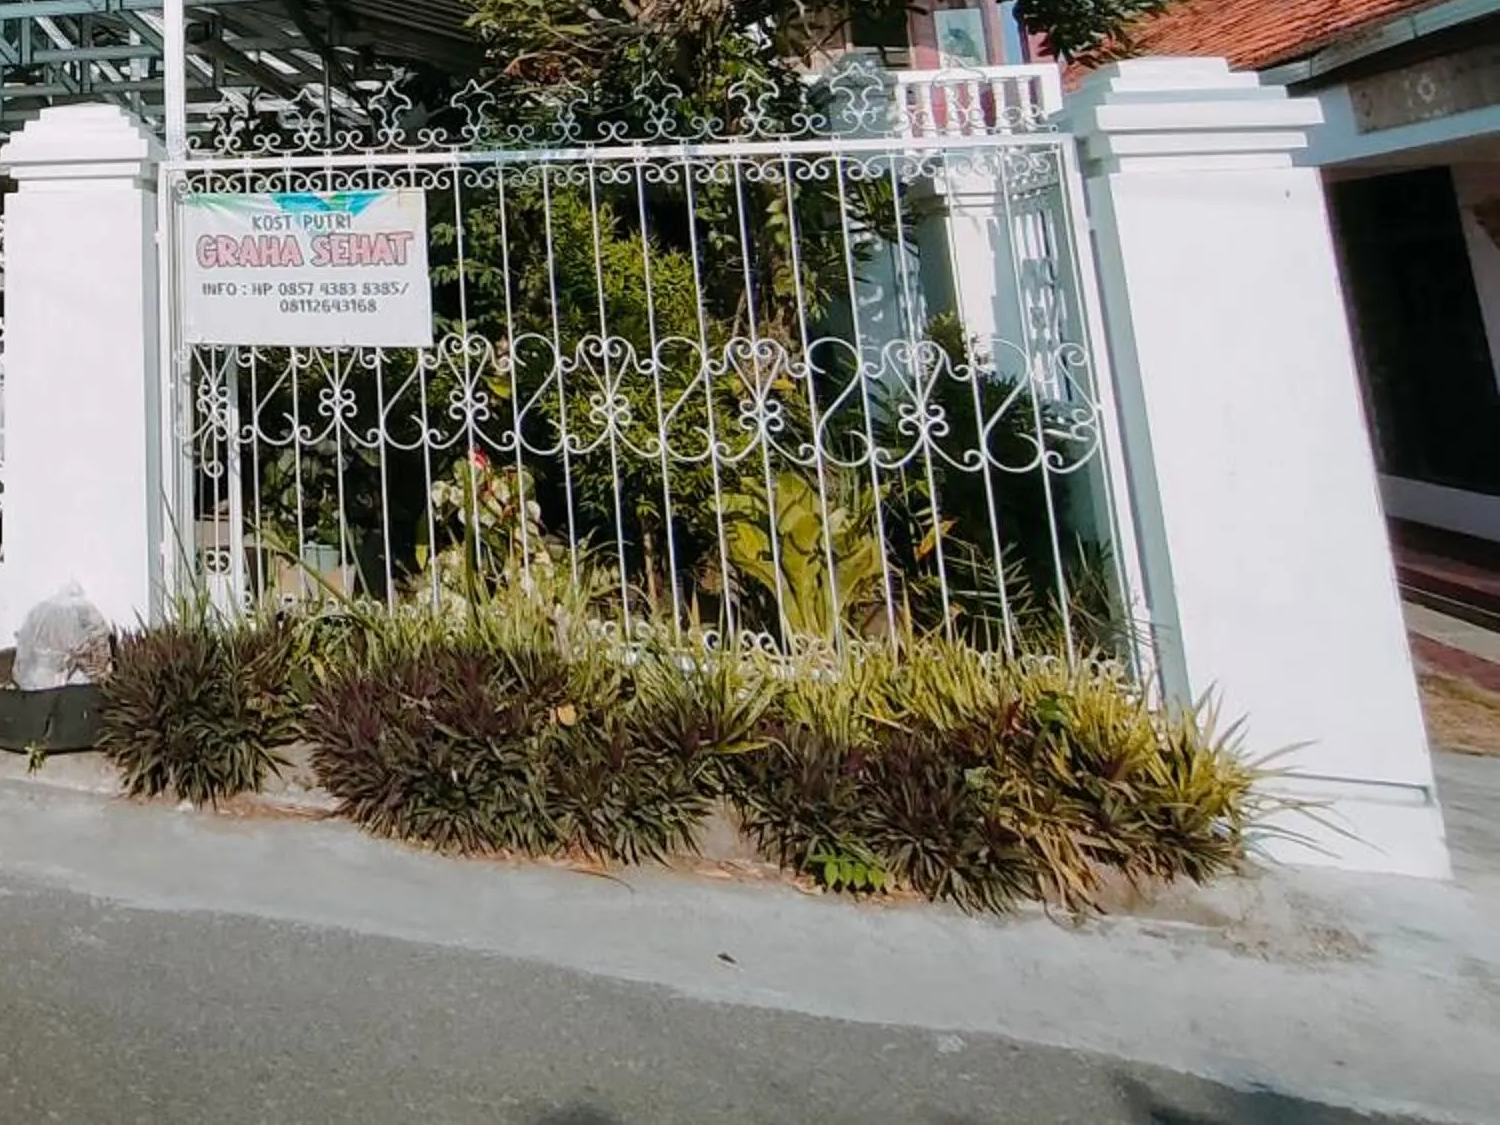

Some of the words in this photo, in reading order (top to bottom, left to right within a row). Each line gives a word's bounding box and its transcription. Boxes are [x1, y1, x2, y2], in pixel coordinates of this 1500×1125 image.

[251, 214, 293, 231] KOST
[303, 213, 352, 230] PUTRI
[196, 234, 305, 269] GRAHA
[310, 231, 414, 268] SEHAT
[202, 282, 237, 296] INFO
[251, 282, 273, 296] HP
[278, 282, 314, 296] 0857
